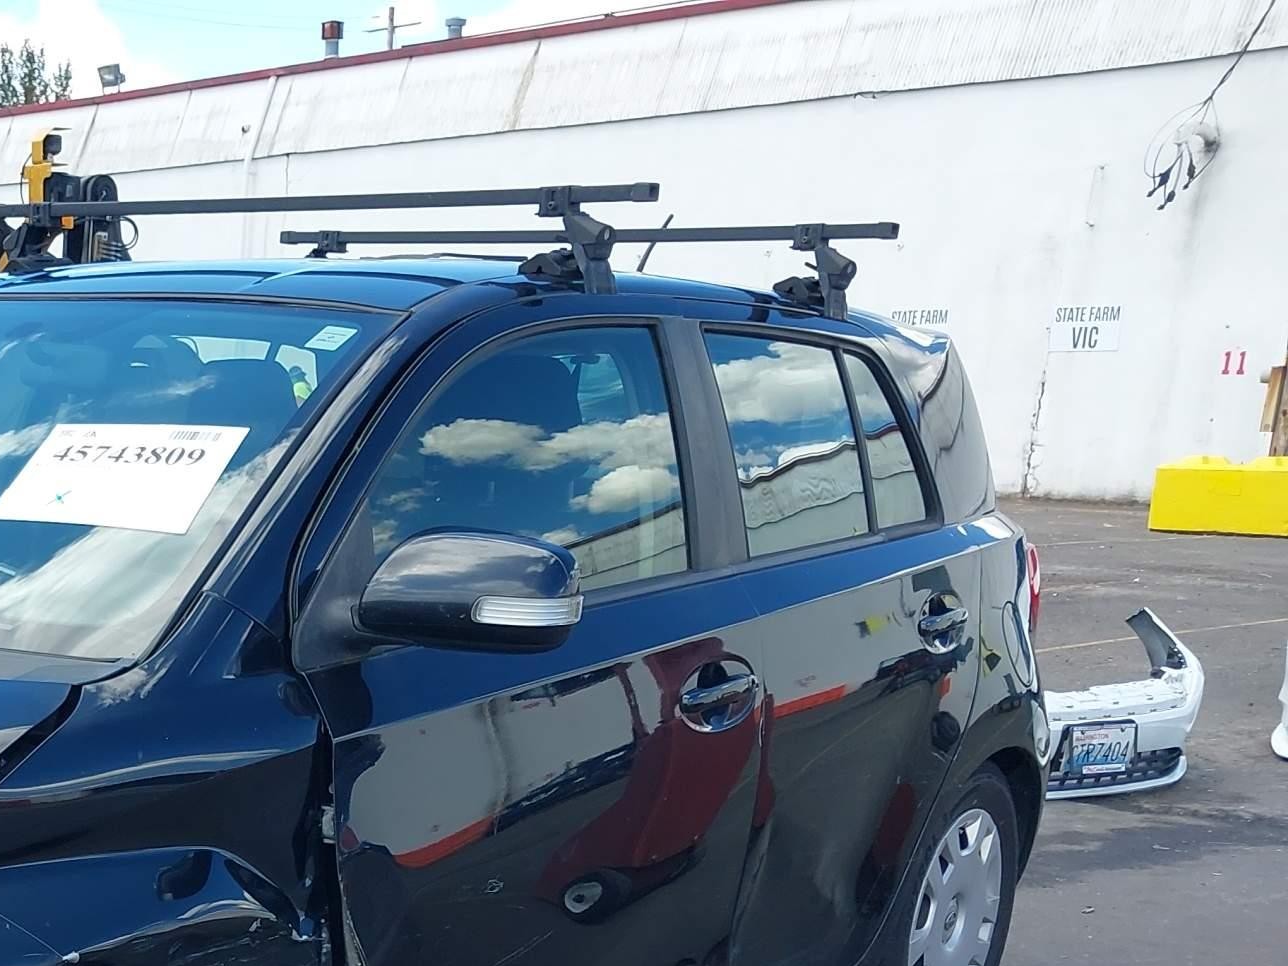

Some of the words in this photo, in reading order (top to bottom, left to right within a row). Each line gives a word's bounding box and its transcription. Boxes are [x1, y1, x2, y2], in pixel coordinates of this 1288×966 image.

[891, 310, 919, 326] STATE
[919, 309, 949, 325] FARM
[1055, 306, 1088, 323] STATE
[1088, 305, 1121, 322] FARM
[1072, 325, 1099, 349] VIC
[1221, 350, 1248, 375] 11
[52, 444, 206, 466] 45743809
